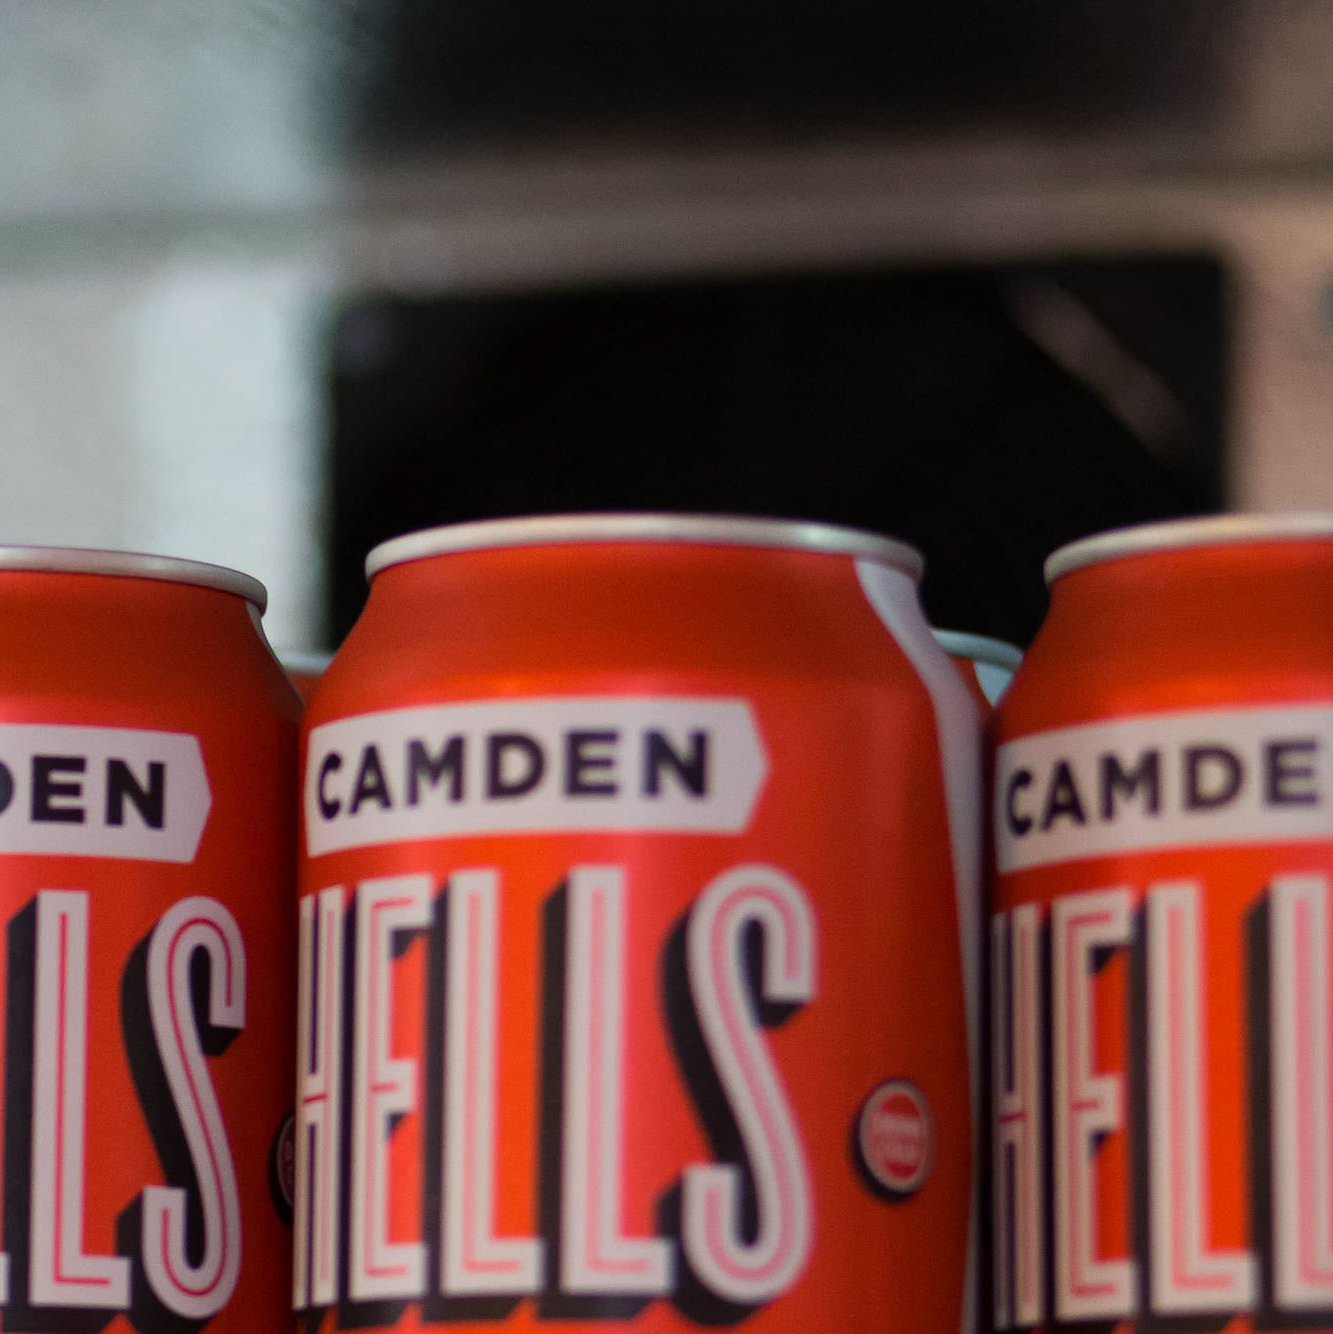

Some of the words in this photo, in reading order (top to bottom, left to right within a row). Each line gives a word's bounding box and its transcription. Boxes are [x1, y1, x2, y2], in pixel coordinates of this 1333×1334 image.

[316, 728, 711, 823] CAMDEN
[1004, 738, 1320, 837] CAMDE
[291, 862, 819, 1328] HELLS
